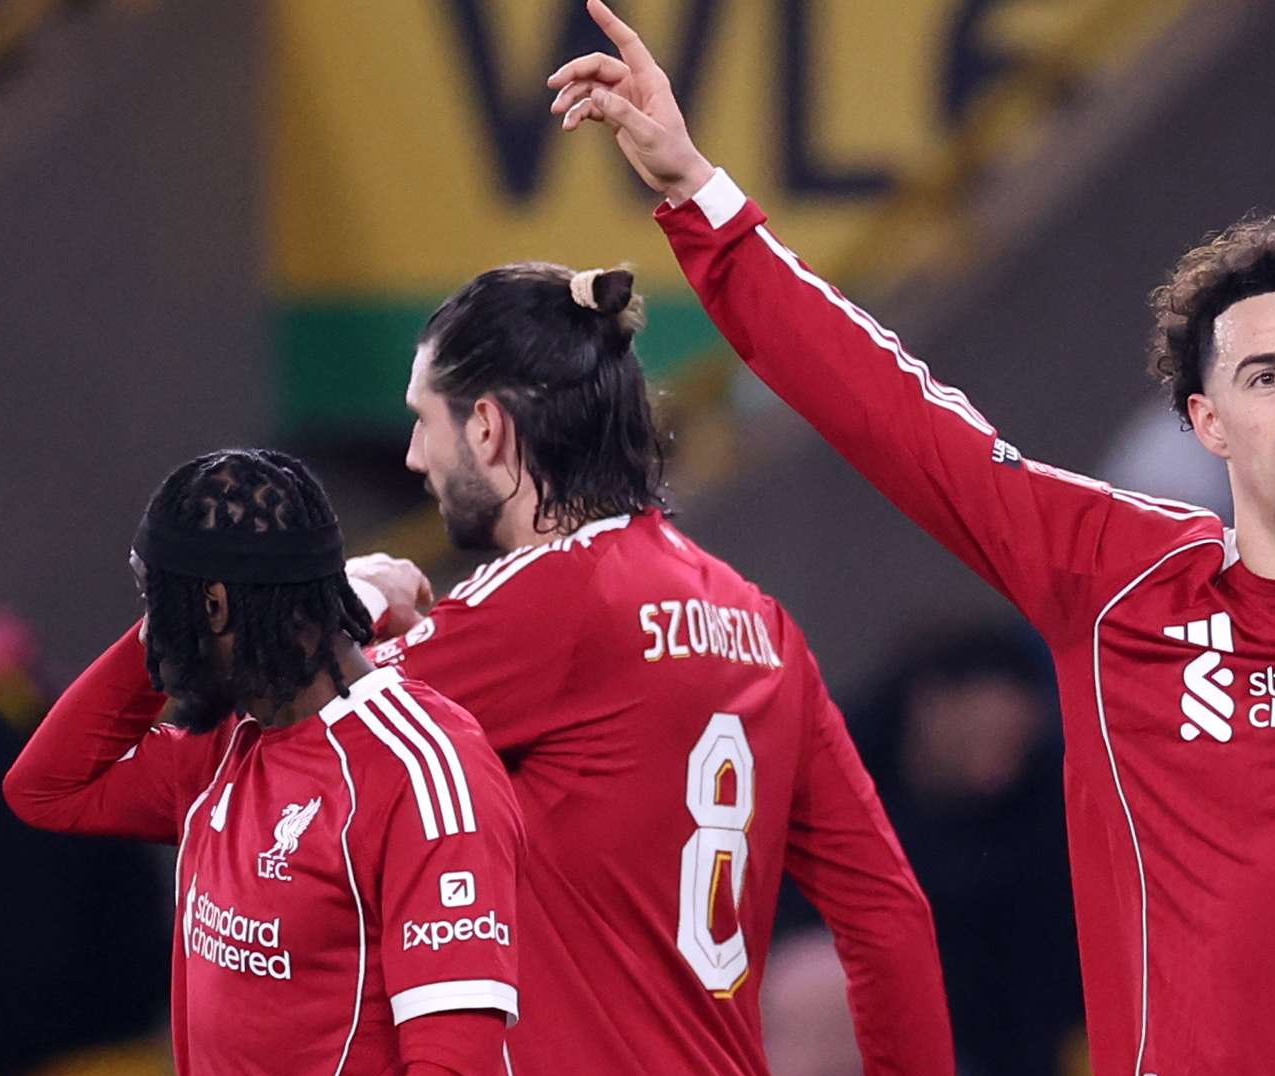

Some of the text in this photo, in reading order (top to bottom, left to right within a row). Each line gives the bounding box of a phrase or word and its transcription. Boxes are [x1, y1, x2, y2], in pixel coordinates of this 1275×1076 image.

[676, 711, 756, 998] 8
[195, 891, 280, 949] standard
[403, 910, 511, 951] Expeda
[191, 923, 292, 981] chartered
